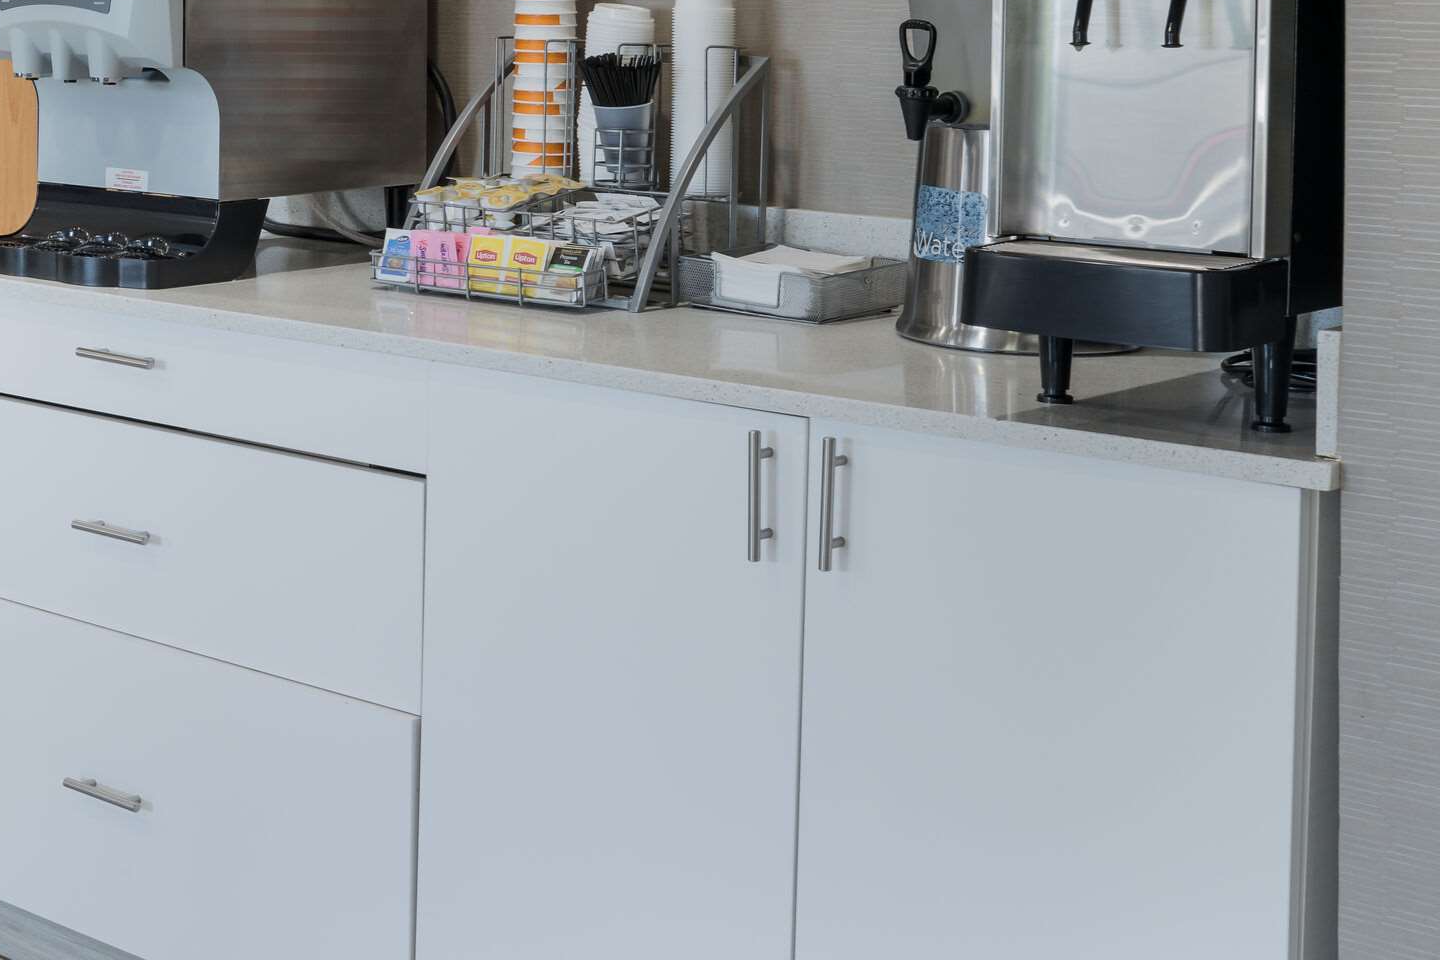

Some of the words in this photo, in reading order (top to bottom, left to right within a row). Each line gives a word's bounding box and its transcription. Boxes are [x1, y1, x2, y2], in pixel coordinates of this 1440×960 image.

[914, 227, 965, 259] Wate
[476, 251, 497, 261] Lipton
[514, 253, 536, 264] Lipton
